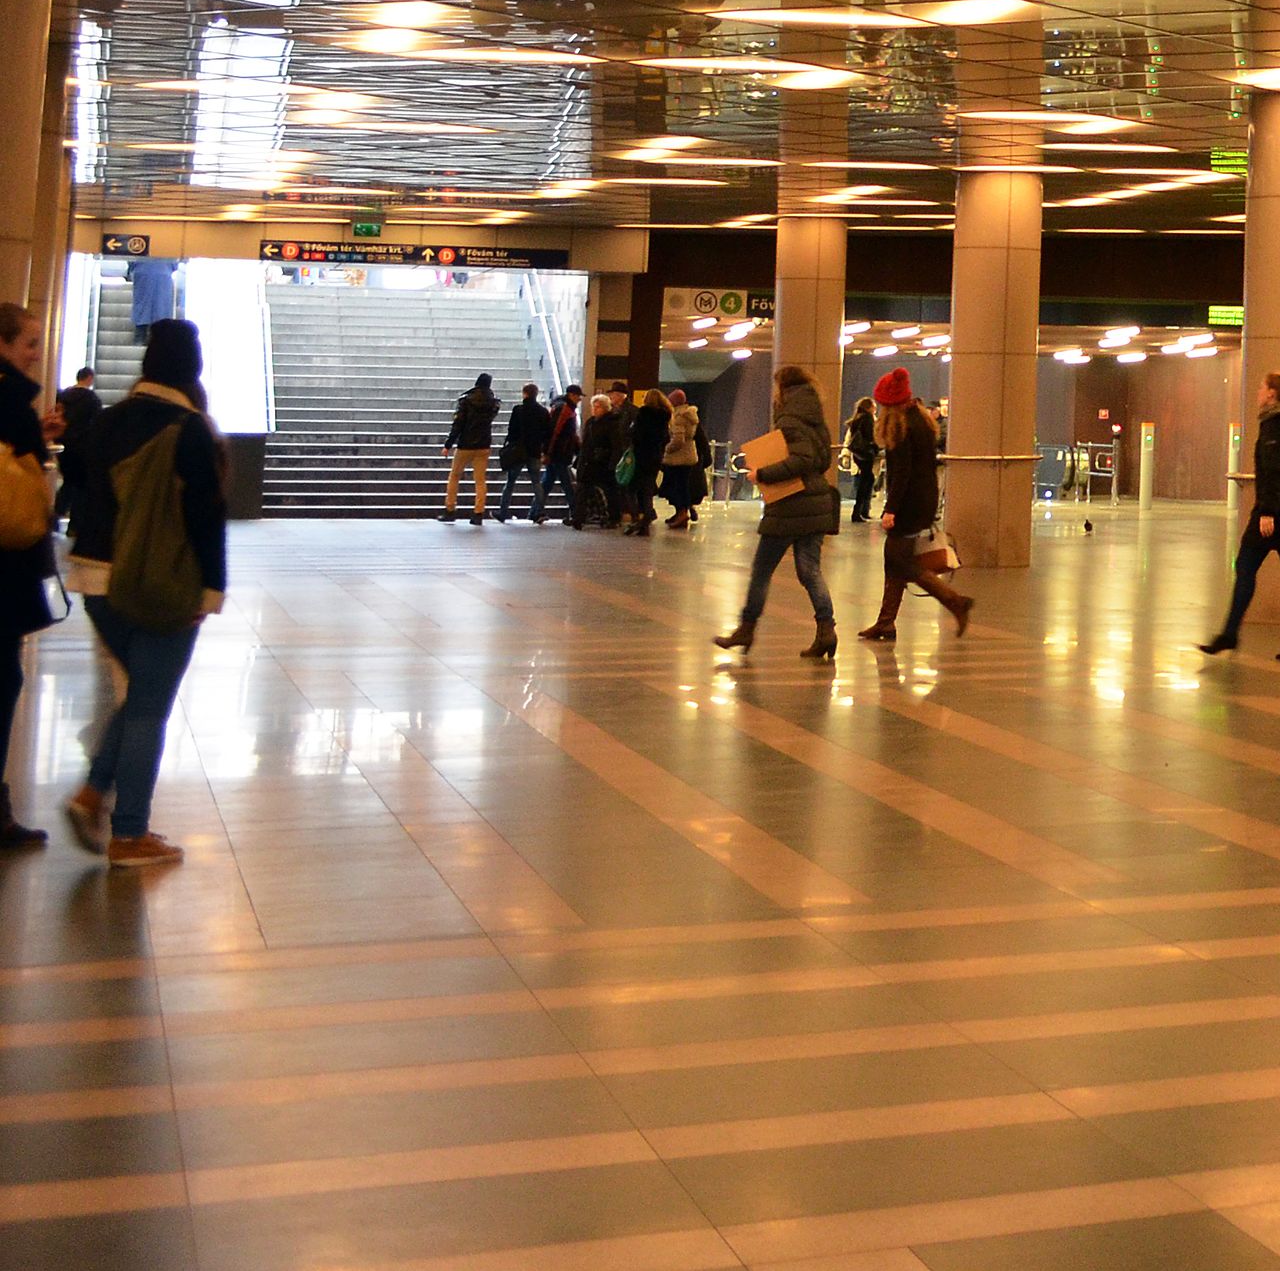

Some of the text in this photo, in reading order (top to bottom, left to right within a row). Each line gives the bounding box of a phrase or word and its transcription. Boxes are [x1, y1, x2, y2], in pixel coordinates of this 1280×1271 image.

[340, 244, 353, 252] tér
[496, 249, 508, 257] tér
[725, 297, 736, 310] 4
